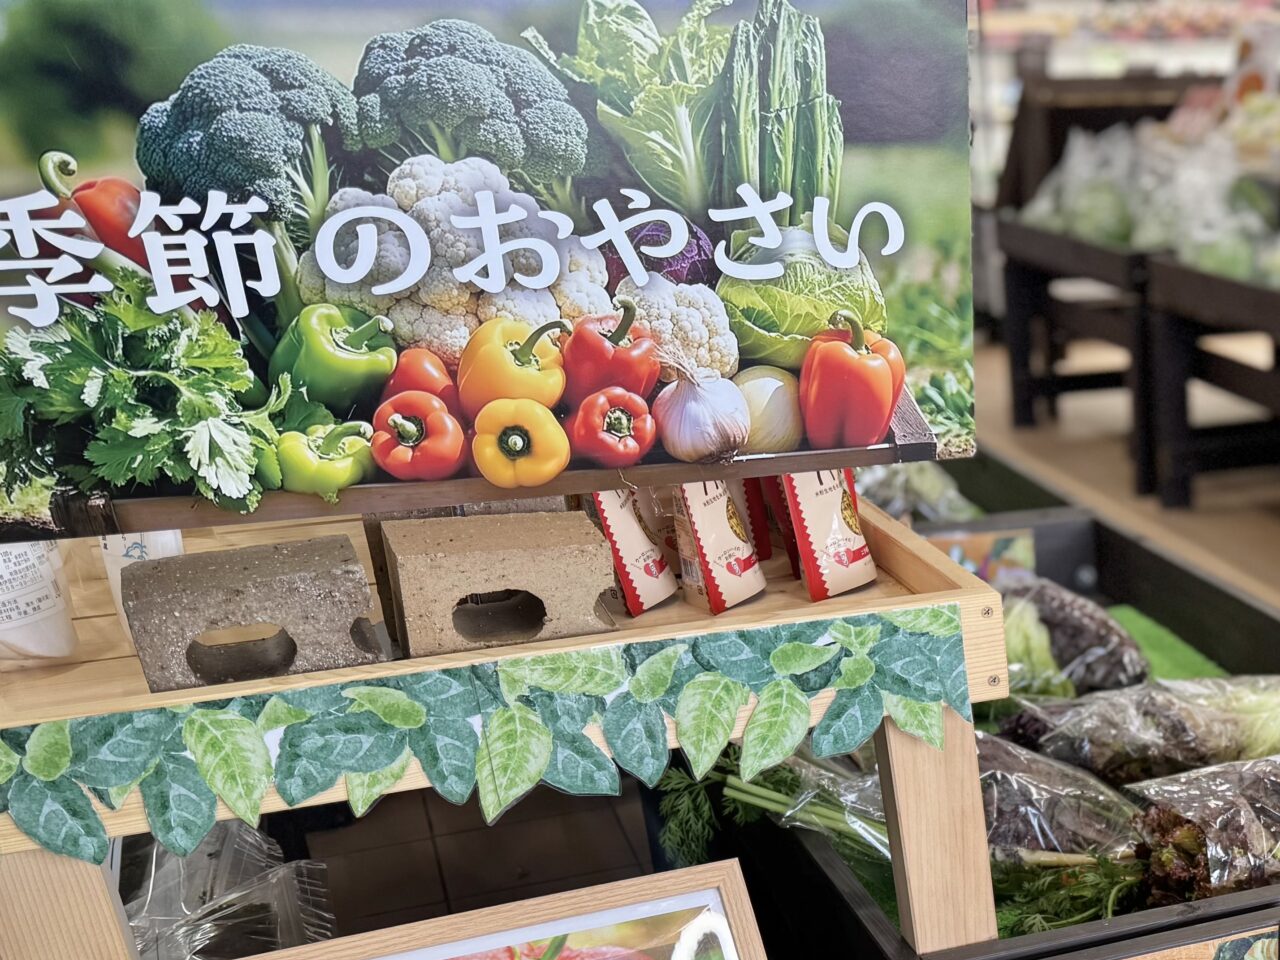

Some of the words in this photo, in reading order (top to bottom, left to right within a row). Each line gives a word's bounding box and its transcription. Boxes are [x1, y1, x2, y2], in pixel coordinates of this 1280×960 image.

[0, 182, 908, 330] 季節のおやさい
